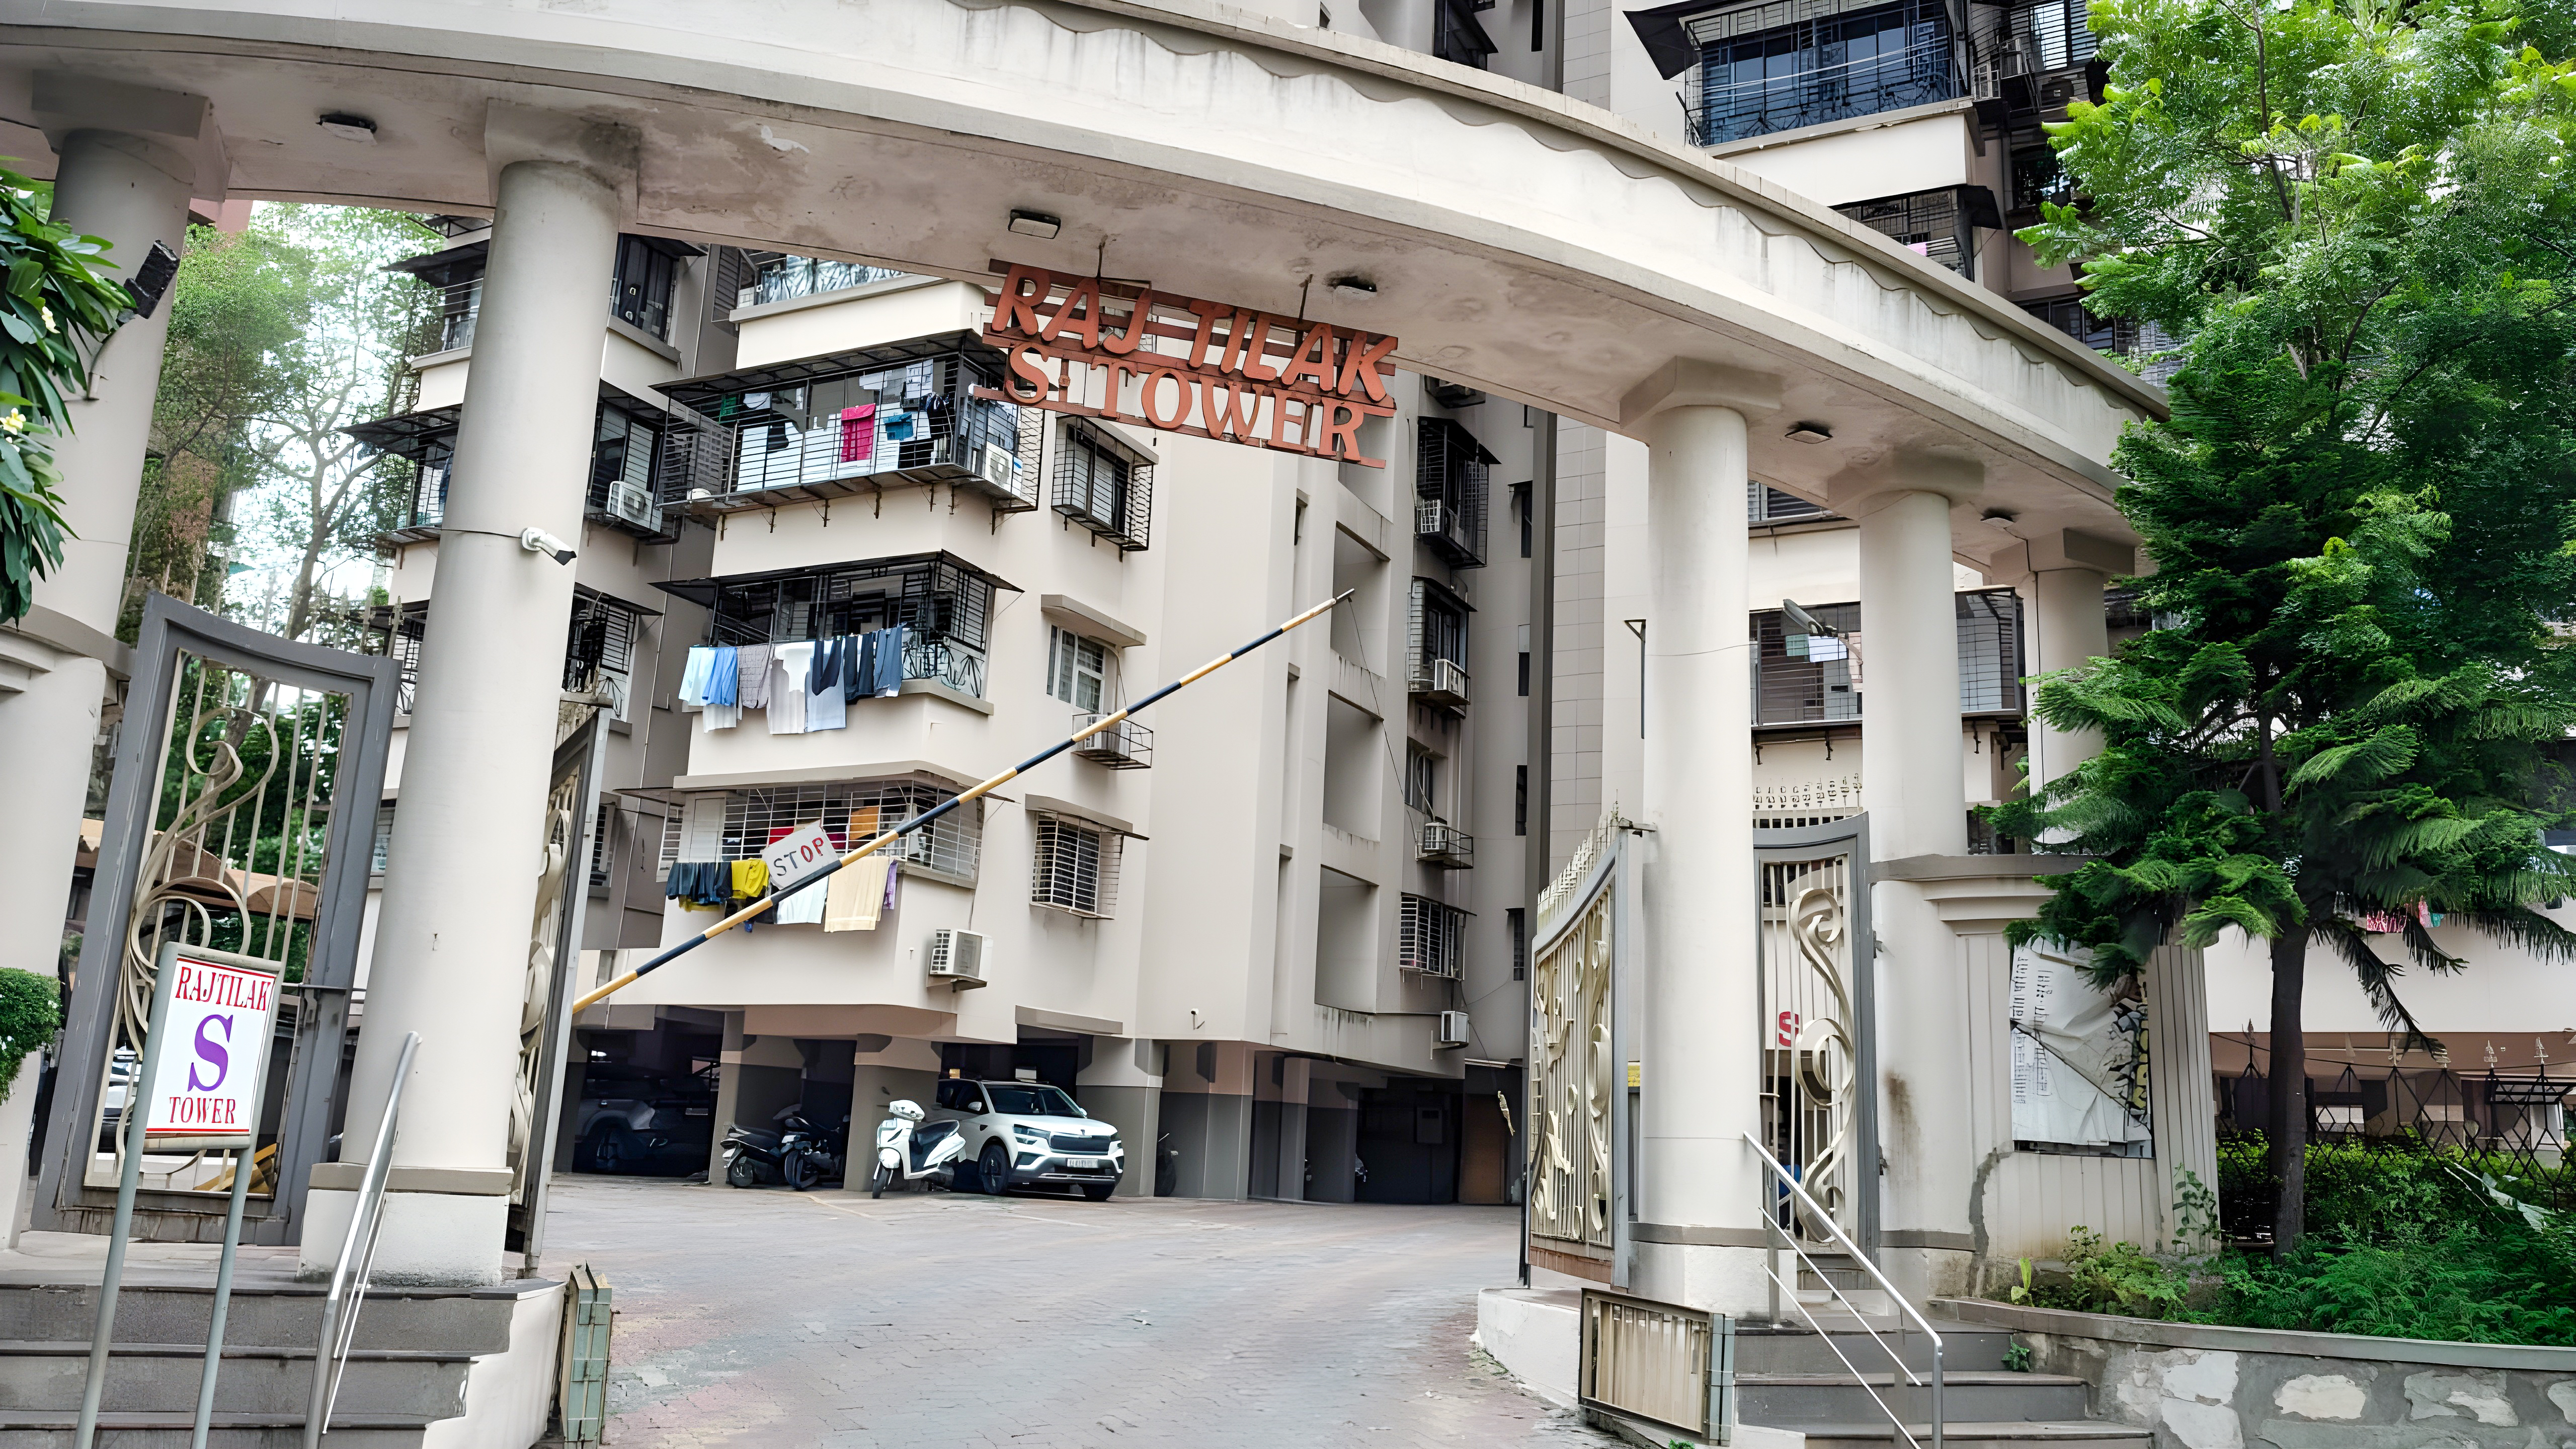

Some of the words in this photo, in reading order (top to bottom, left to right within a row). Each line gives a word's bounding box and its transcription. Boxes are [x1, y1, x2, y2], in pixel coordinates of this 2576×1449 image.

[991, 264, 1152, 354] RAJ
[1187, 301, 1398, 401] TILAK
[1090, 357, 1365, 461] TOWER
[774, 837, 824, 876] STOP
[175, 967, 271, 1011] RAJTILAK
[187, 1014, 233, 1092] S
[169, 1097, 236, 1124] TOWER
